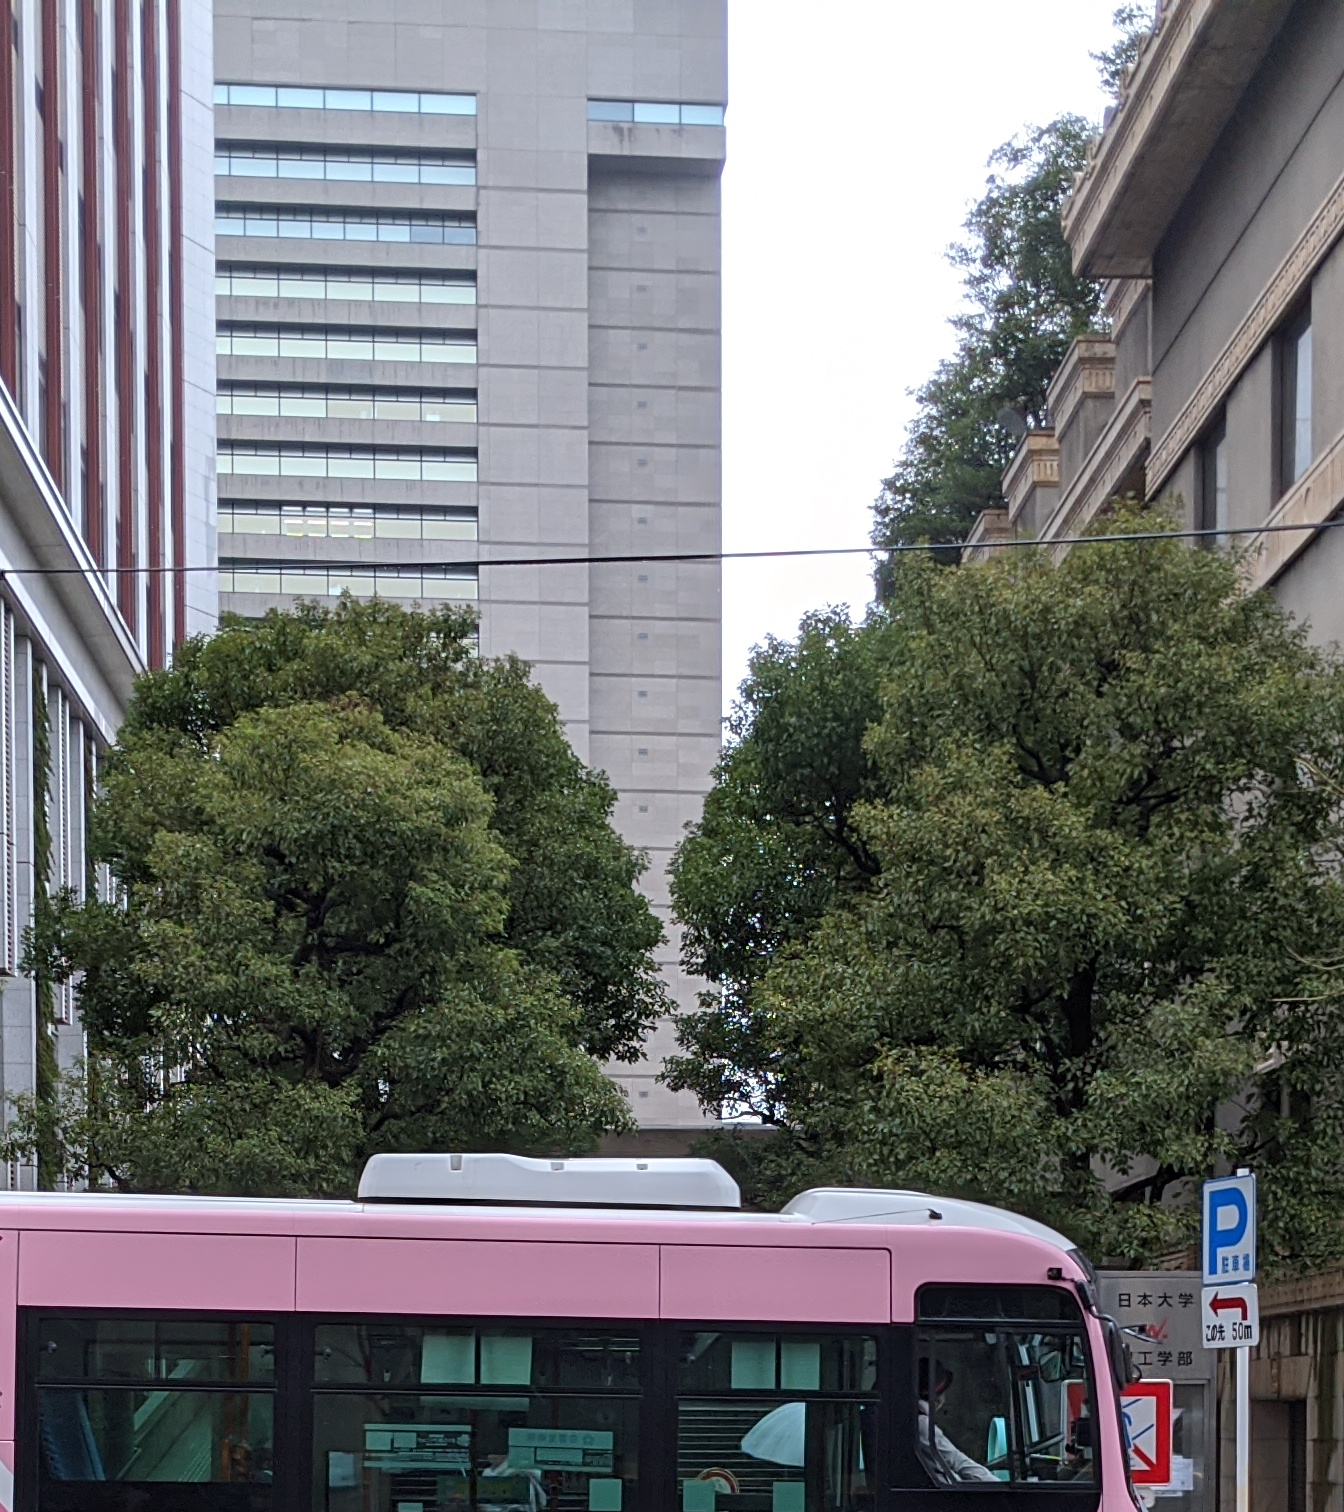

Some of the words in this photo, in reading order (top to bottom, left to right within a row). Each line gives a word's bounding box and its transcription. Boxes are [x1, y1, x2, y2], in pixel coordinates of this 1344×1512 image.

[1209, 1187, 1248, 1275] P
[1118, 1292, 1194, 1308] 日本大学
[1205, 1323, 1225, 1342] この先
[1232, 1321, 1253, 1341] 50m
[1130, 1350, 1193, 1366] 工学部
